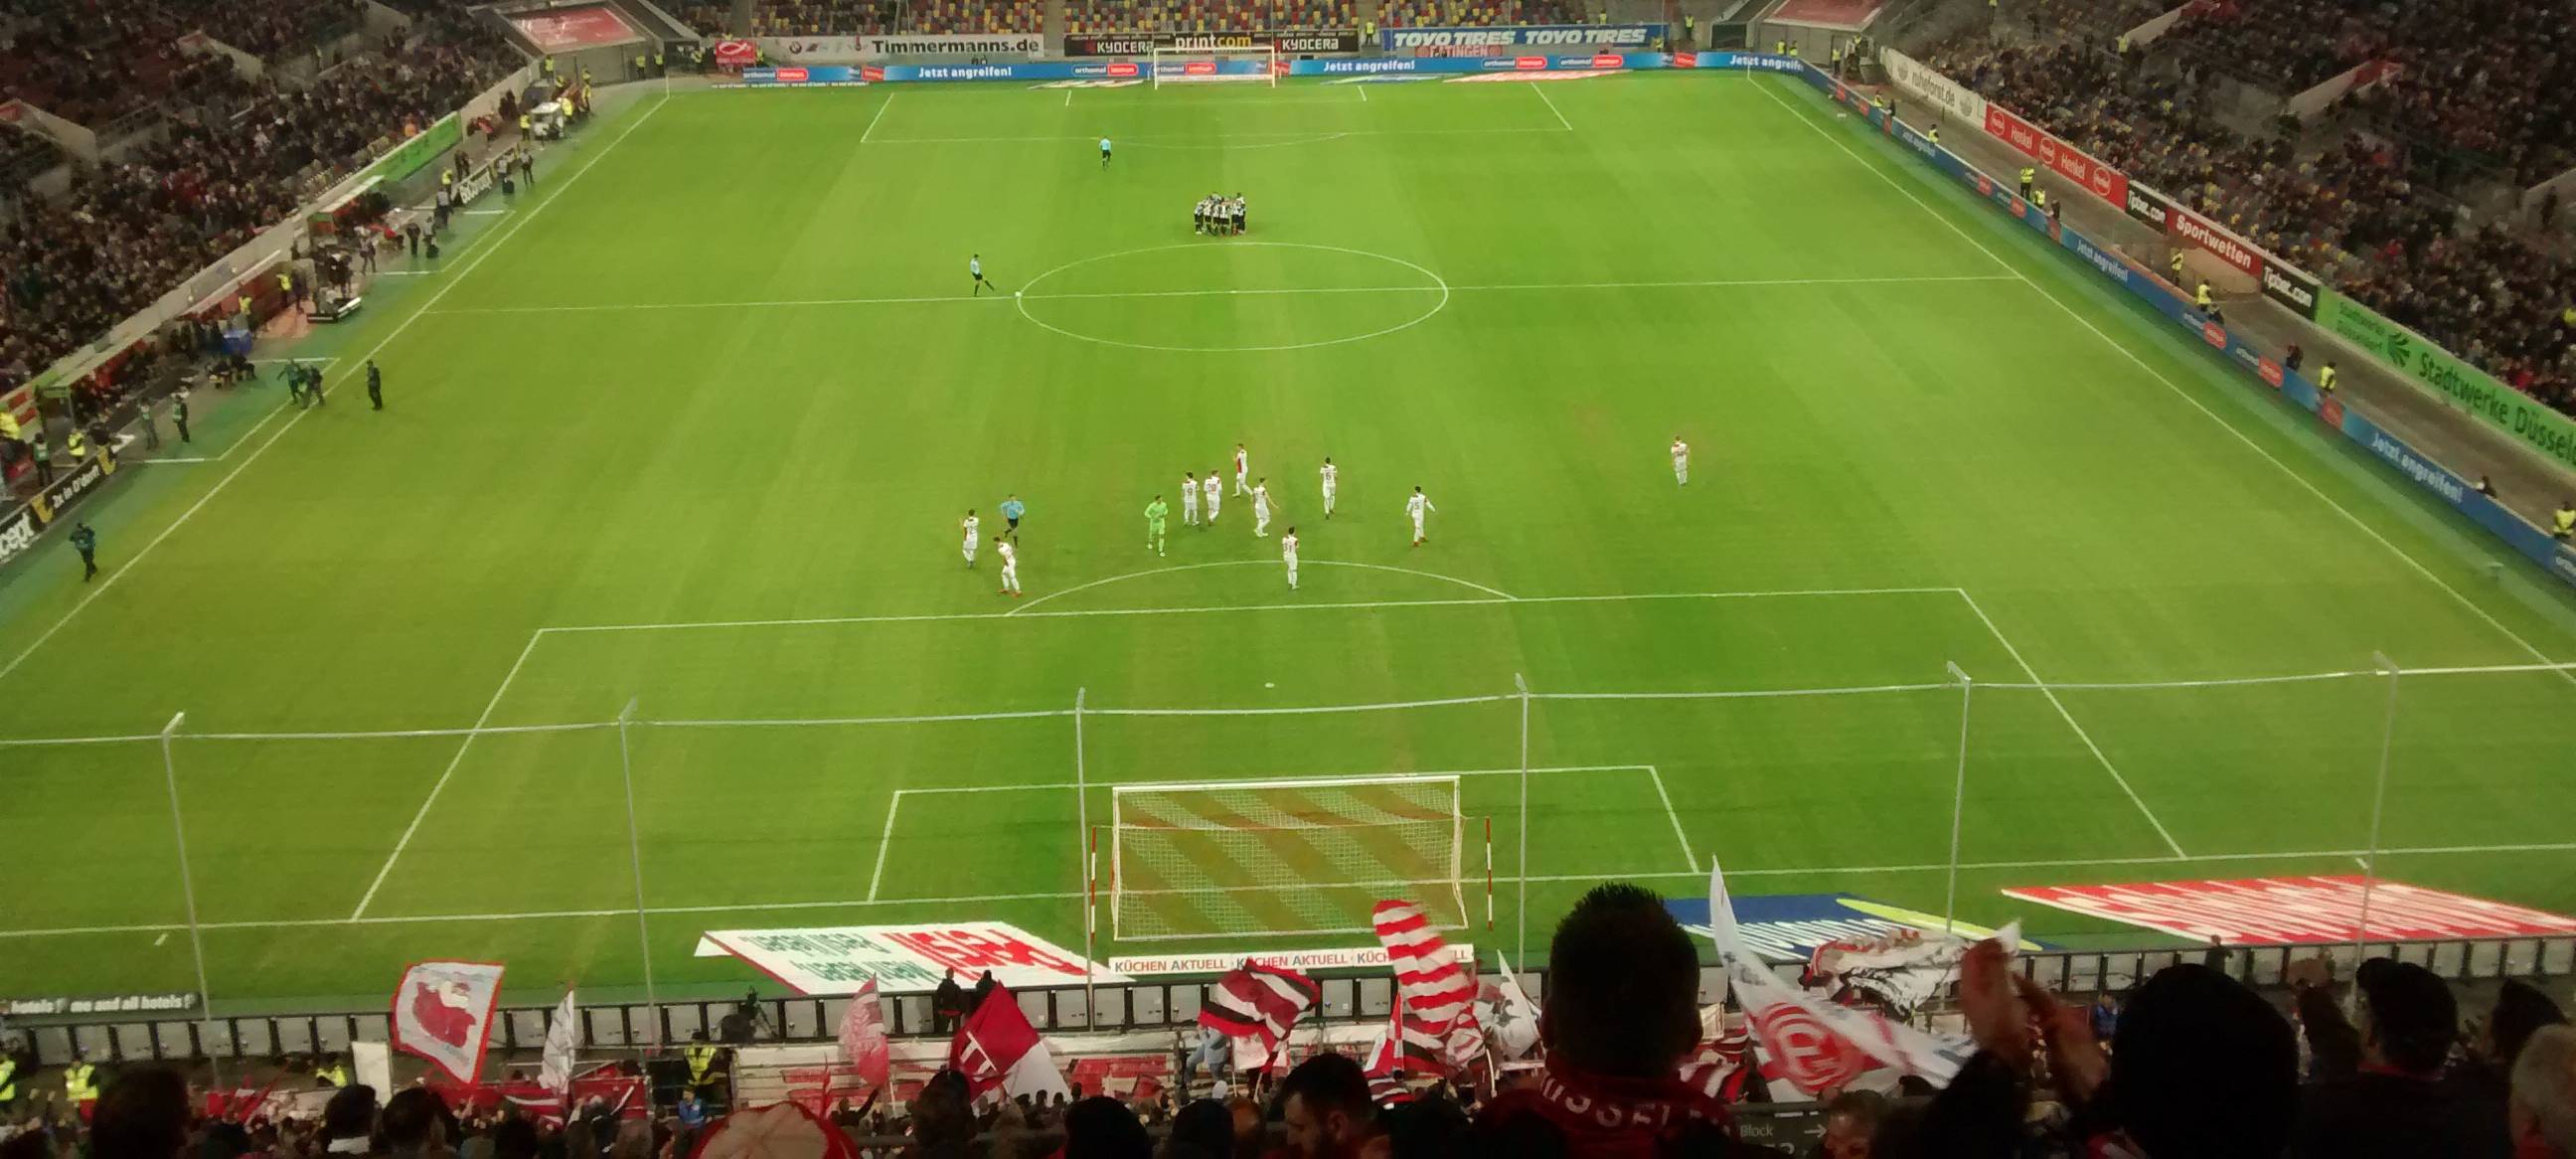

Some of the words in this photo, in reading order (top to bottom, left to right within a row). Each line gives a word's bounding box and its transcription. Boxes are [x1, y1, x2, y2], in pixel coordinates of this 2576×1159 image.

[872, 38, 1039, 54] Timmermanns.de
[1175, 34, 1252, 53] printcom
[1282, 38, 1339, 51] KYOCERA
[1393, 32, 1452, 47] TOYO
[1452, 31, 1516, 45] TIRES
[1525, 30, 1582, 45] TOYO
[1583, 29, 1647, 44] TIRES
[1096, 41, 1154, 54] KYOCERA
[1323, 62, 1354, 73] Jetzt
[1356, 60, 1415, 73] angreifen!
[1729, 55, 1759, 67] Jetzt
[917, 67, 948, 79] Jetzt
[951, 65, 1012, 79] angreifen!
[2175, 214, 2252, 269] Sportwetten
[2418, 351, 2508, 425] Stadtwerke
[2401, 454, 2463, 504] angreifen!
[1114, 958, 1168, 973] KÜCHEN
[1171, 957, 1226, 971] AKTUELL
[1235, 955, 1289, 971] KCHEN
[1292, 951, 1347, 966] AKTUELL
[94, 996, 120, 1012] and
[121, 995, 139, 1011] all
[140, 994, 183, 1010] hotels
[1740, 1123, 1774, 1138] Block
